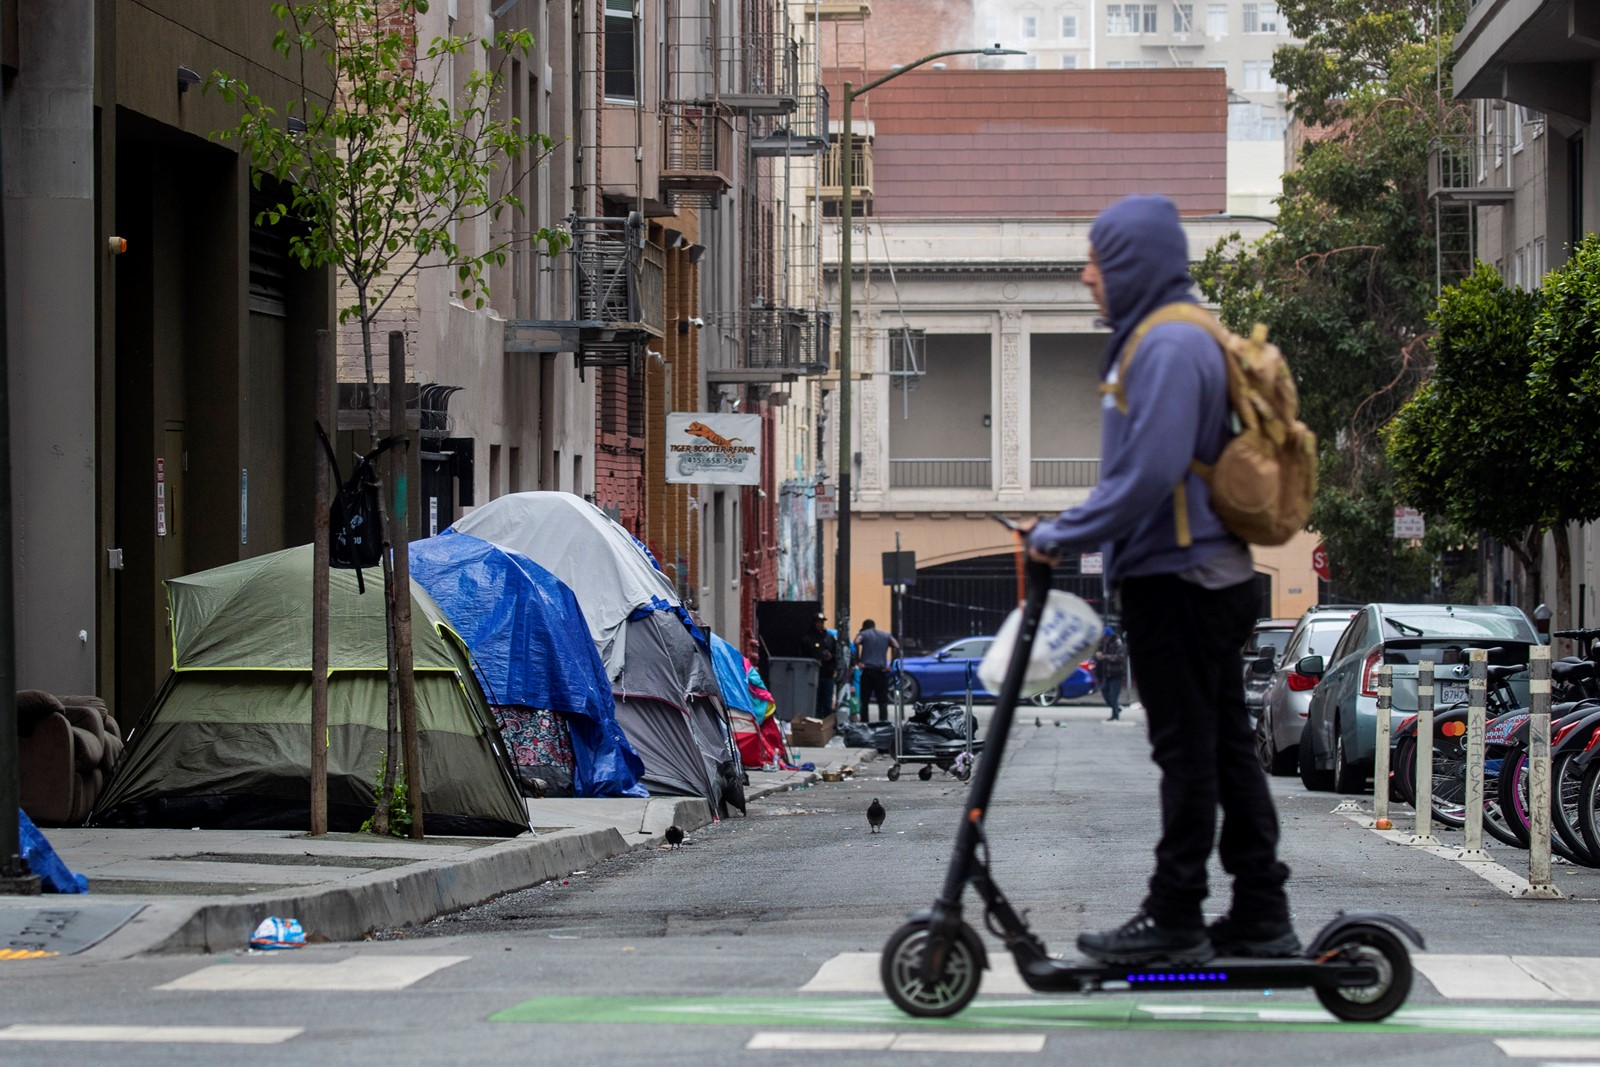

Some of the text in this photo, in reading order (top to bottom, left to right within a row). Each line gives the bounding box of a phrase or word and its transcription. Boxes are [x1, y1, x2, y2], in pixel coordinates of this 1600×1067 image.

[670, 445, 757, 455] TIGER SCOOTER REPAIR
[685, 457, 743, 465] (415) 658 7398
